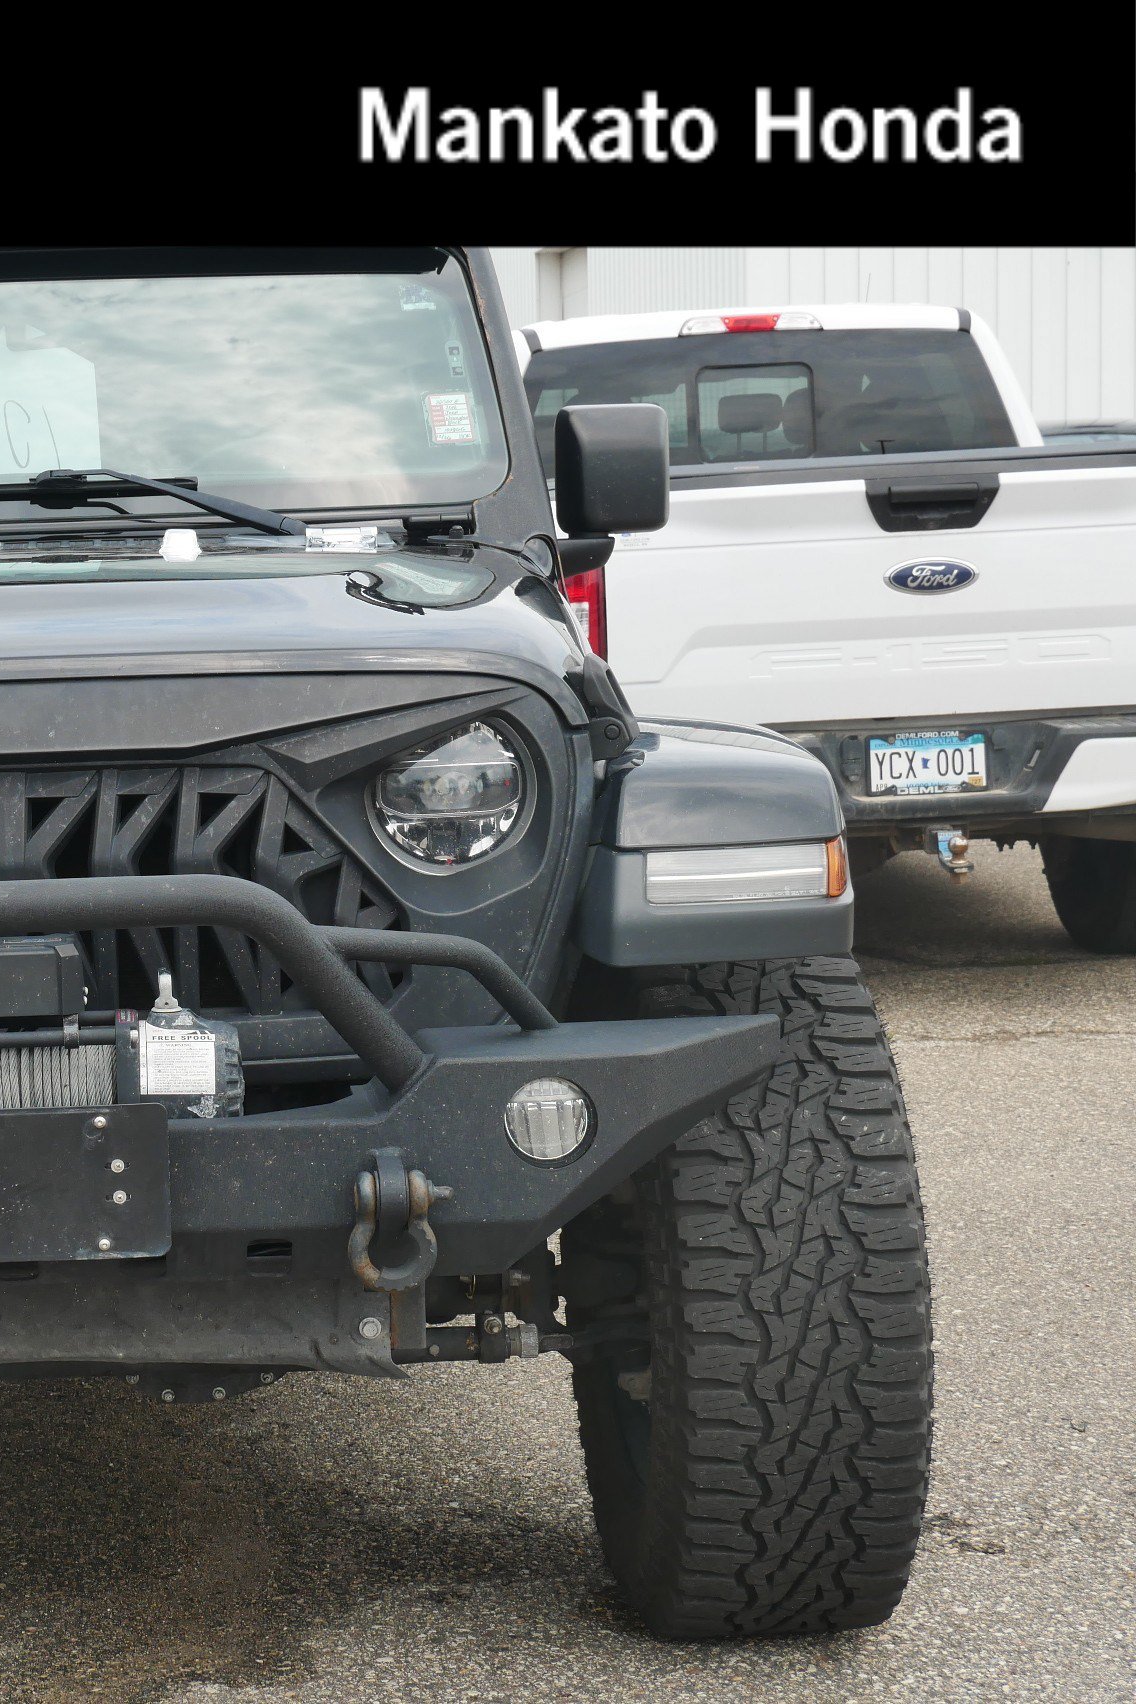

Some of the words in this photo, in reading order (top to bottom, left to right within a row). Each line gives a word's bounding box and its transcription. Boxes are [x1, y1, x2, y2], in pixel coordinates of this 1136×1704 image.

[907, 565, 958, 587] Ford
[749, 634, 1112, 678] F-150
[895, 731, 960, 740] DEMLFORD.COM
[875, 751, 917, 780] YCX
[937, 748, 979, 776] 001
